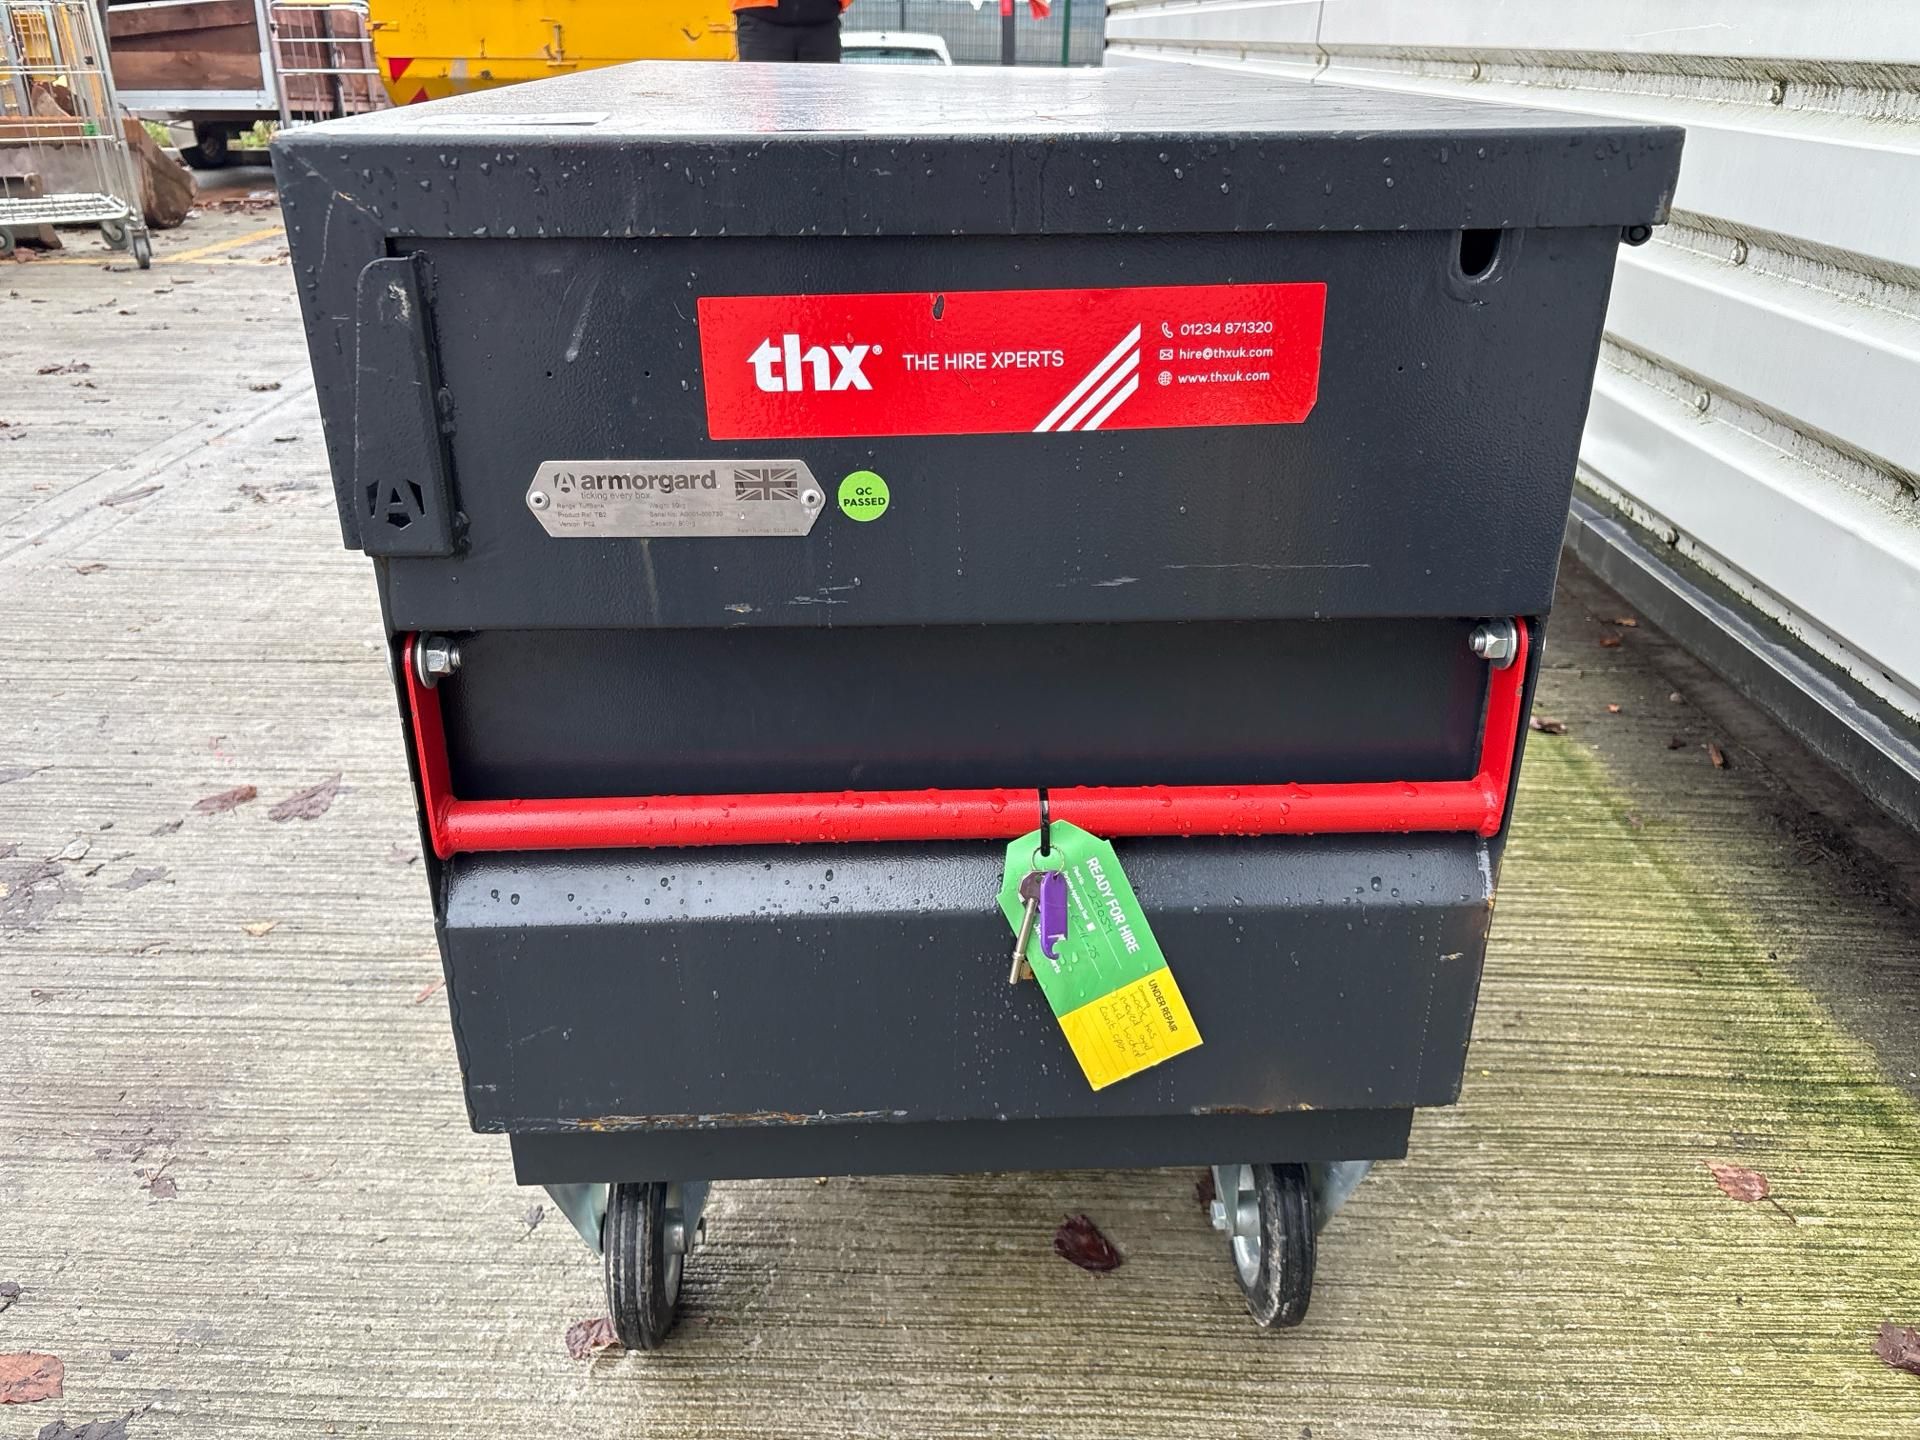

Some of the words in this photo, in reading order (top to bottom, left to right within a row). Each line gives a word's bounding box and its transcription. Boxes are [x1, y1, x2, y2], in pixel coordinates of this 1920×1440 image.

[1180, 323, 1221, 336] 01234
[1224, 321, 1273, 335] 871320
[902, 353, 940, 371] THE
[944, 352, 987, 370] HIRE
[991, 350, 1065, 369] XPERTS
[1179, 347, 1273, 361] hire@thxuk.com
[1178, 370, 1270, 384] www.thxuk.com
[581, 470, 717, 494] armorgard
[581, 491, 608, 500] ticking
[855, 487, 873, 496] QC
[843, 497, 886, 507] PASSED
[1086, 857, 1115, 898] READY
[1106, 898, 1126, 926] FOR
[1118, 924, 1141, 954] HIRE
[1148, 979, 1167, 1008] UNDER
[1161, 1006, 1178, 1033] REPAIR
